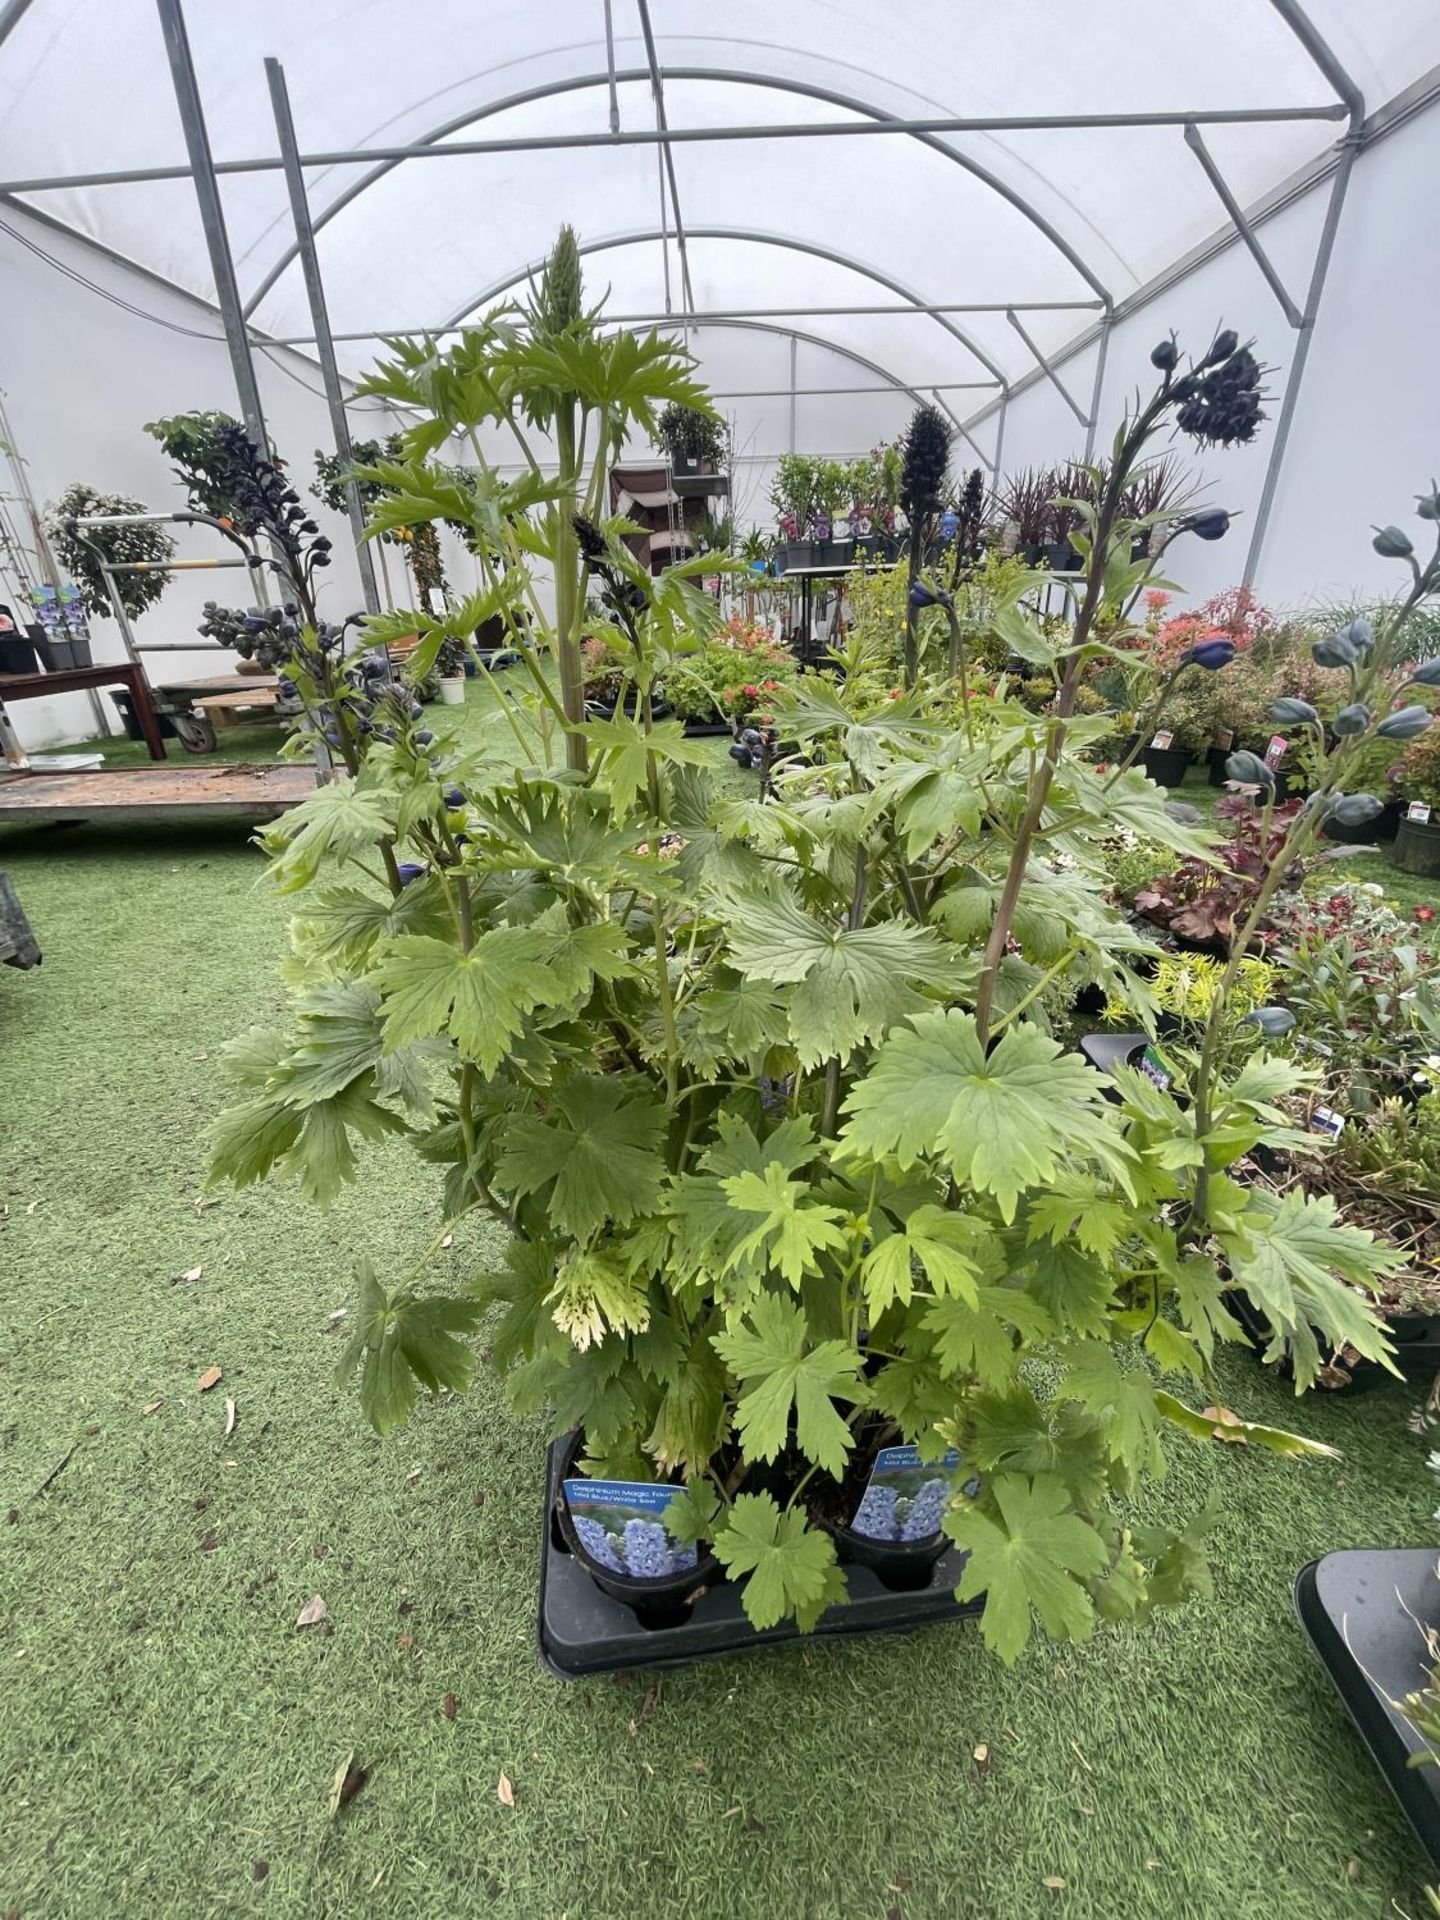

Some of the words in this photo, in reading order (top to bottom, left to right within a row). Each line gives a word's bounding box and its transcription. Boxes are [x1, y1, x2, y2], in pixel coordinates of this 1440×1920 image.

[572, 1484, 620, 1496] Delphinium
[622, 1490, 649, 1499] Magic
[574, 1491, 589, 1499] Mid
